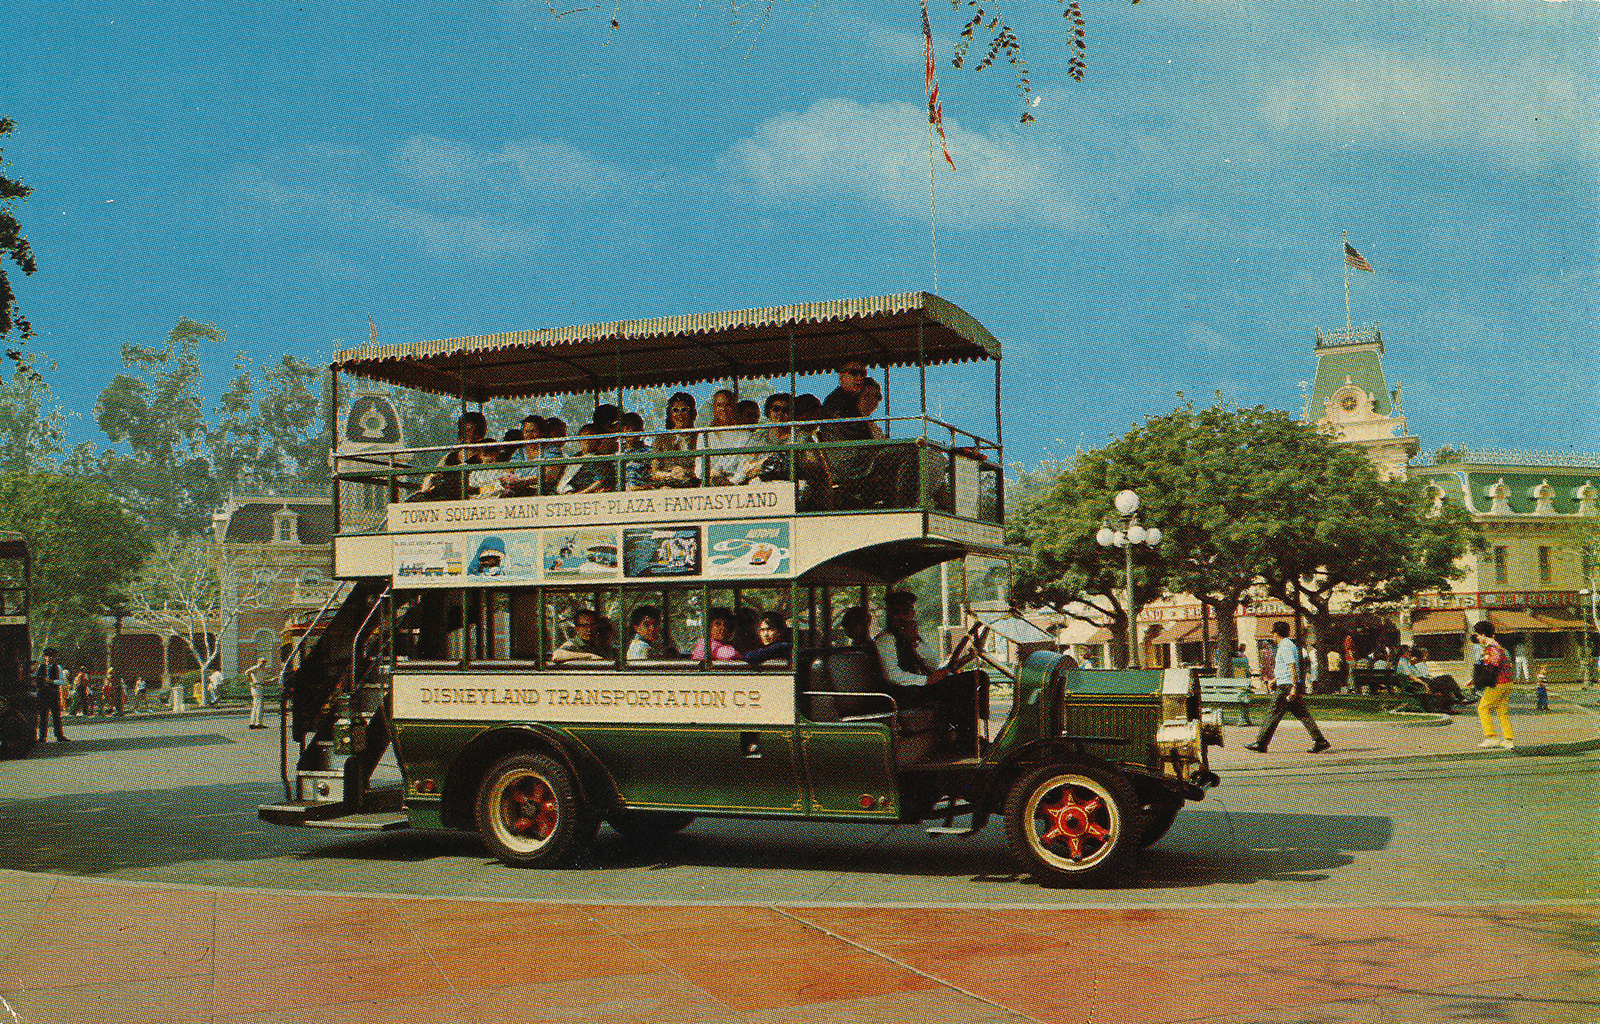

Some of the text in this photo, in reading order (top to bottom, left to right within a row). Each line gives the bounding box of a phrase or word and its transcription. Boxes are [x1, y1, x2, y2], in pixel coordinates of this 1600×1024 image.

[400, 491, 778, 524] TOWN SQUARE MAIN STREET PLAZA FANTASYLAND
[420, 687, 541, 706] DISNEYLAND
[546, 688, 727, 709] TRANSPORTATION
